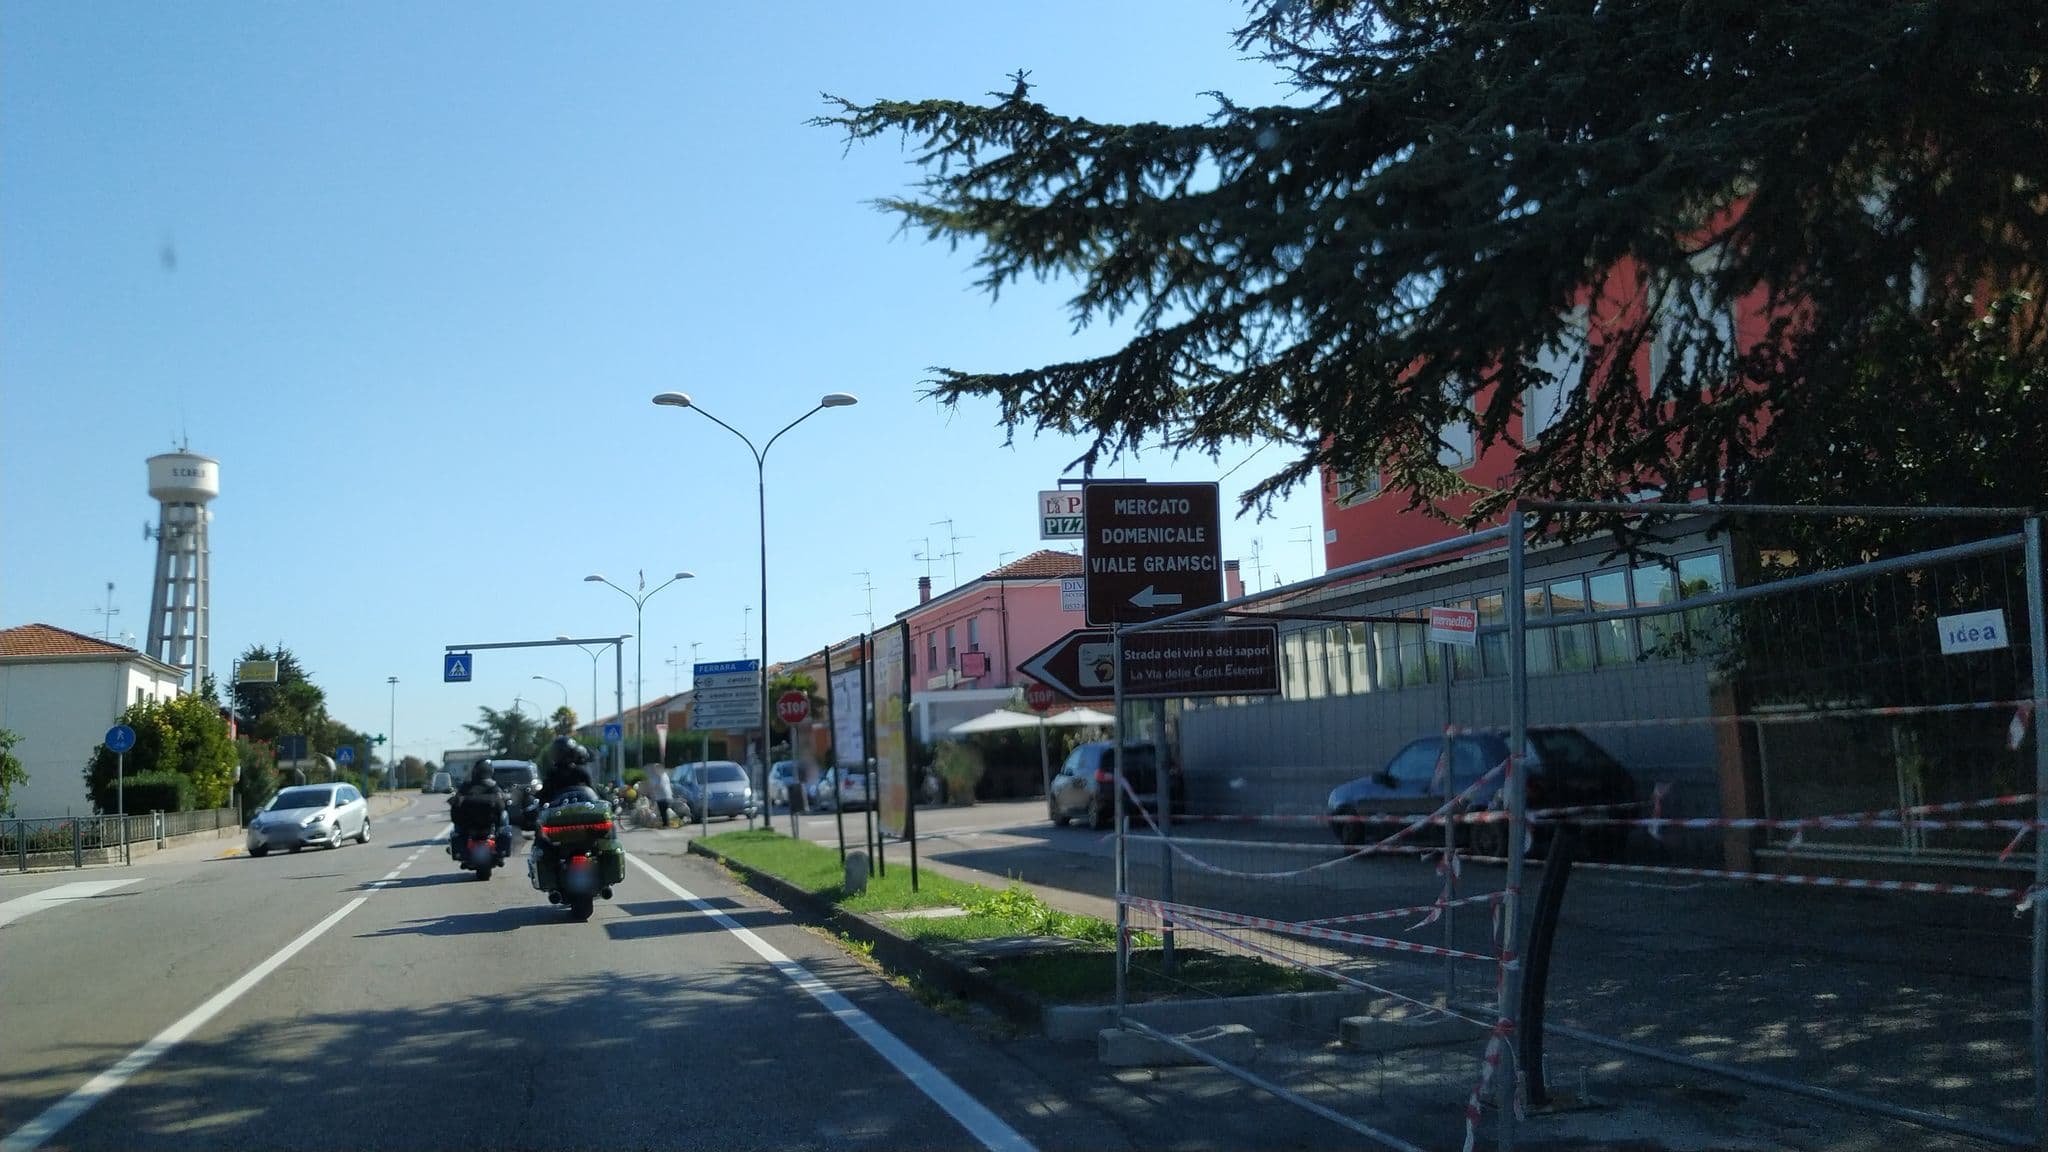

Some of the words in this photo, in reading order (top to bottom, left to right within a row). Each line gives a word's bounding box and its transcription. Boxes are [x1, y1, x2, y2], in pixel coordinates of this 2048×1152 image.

[1067, 496, 1083, 514] P
[1114, 499, 1190, 515] MERCATO
[1102, 527, 1205, 544] DOMENICALE
[1091, 557, 1136, 573] VIALE
[1143, 555, 1217, 572] GRAMSCI
[1949, 622, 1997, 645] idea
[1124, 648, 1161, 661] Strada
[1163, 647, 1181, 659] dei
[1183, 646, 1204, 658] vini
[1206, 649, 1214, 658] e
[1215, 646, 1233, 657] dei
[1235, 645, 1270, 658] sapori
[699, 663, 737, 673] FERRARA
[1130, 669, 1143, 680] La
[780, 701, 806, 714] STOP
